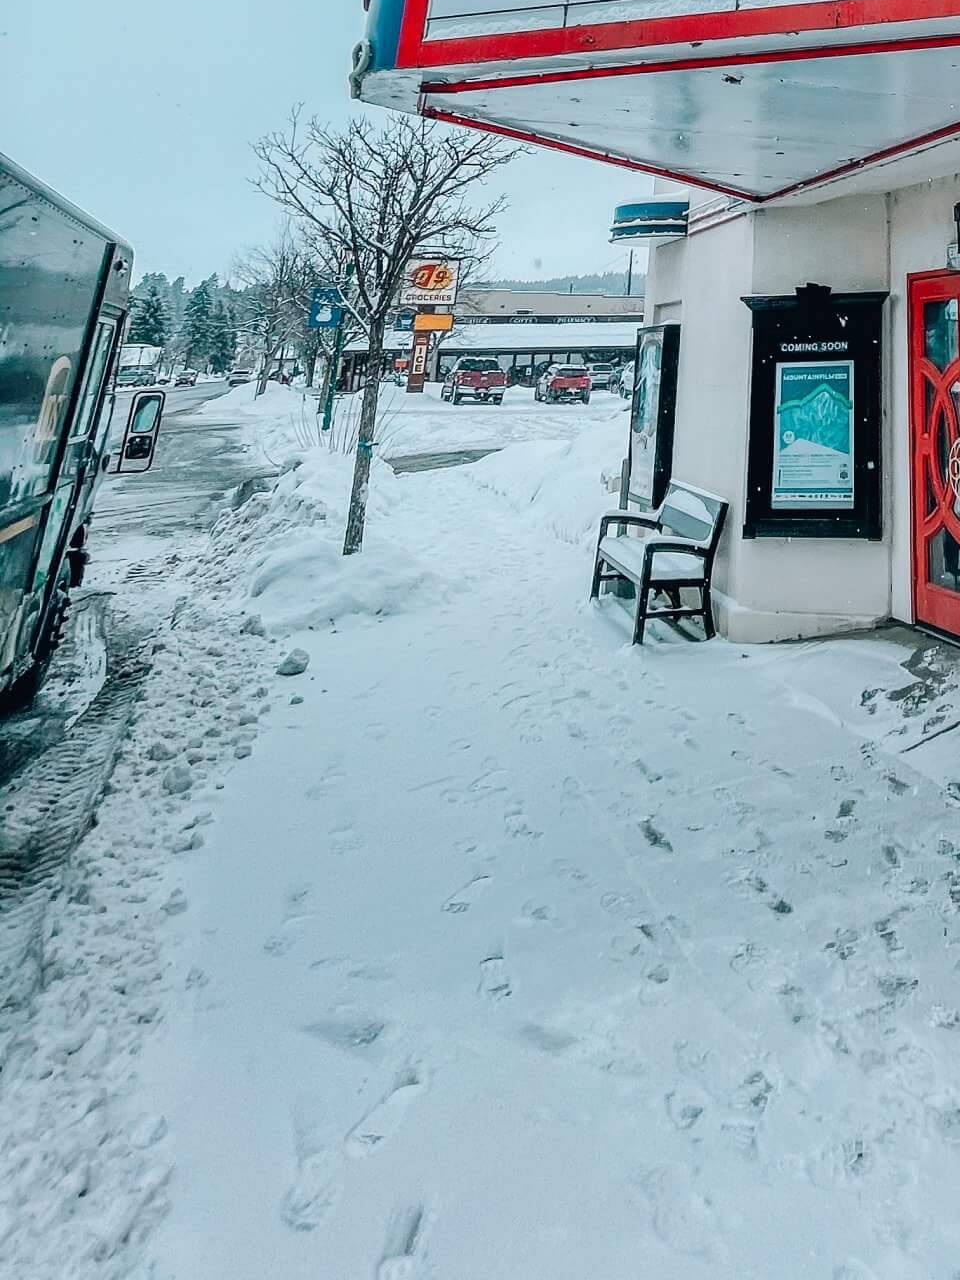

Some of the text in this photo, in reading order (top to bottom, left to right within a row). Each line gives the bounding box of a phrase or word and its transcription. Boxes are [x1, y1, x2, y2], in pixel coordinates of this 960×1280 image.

[405, 294, 452, 302] GROCERIES
[781, 341, 849, 352] COMING SOON
[415, 347, 424, 372] ICE
